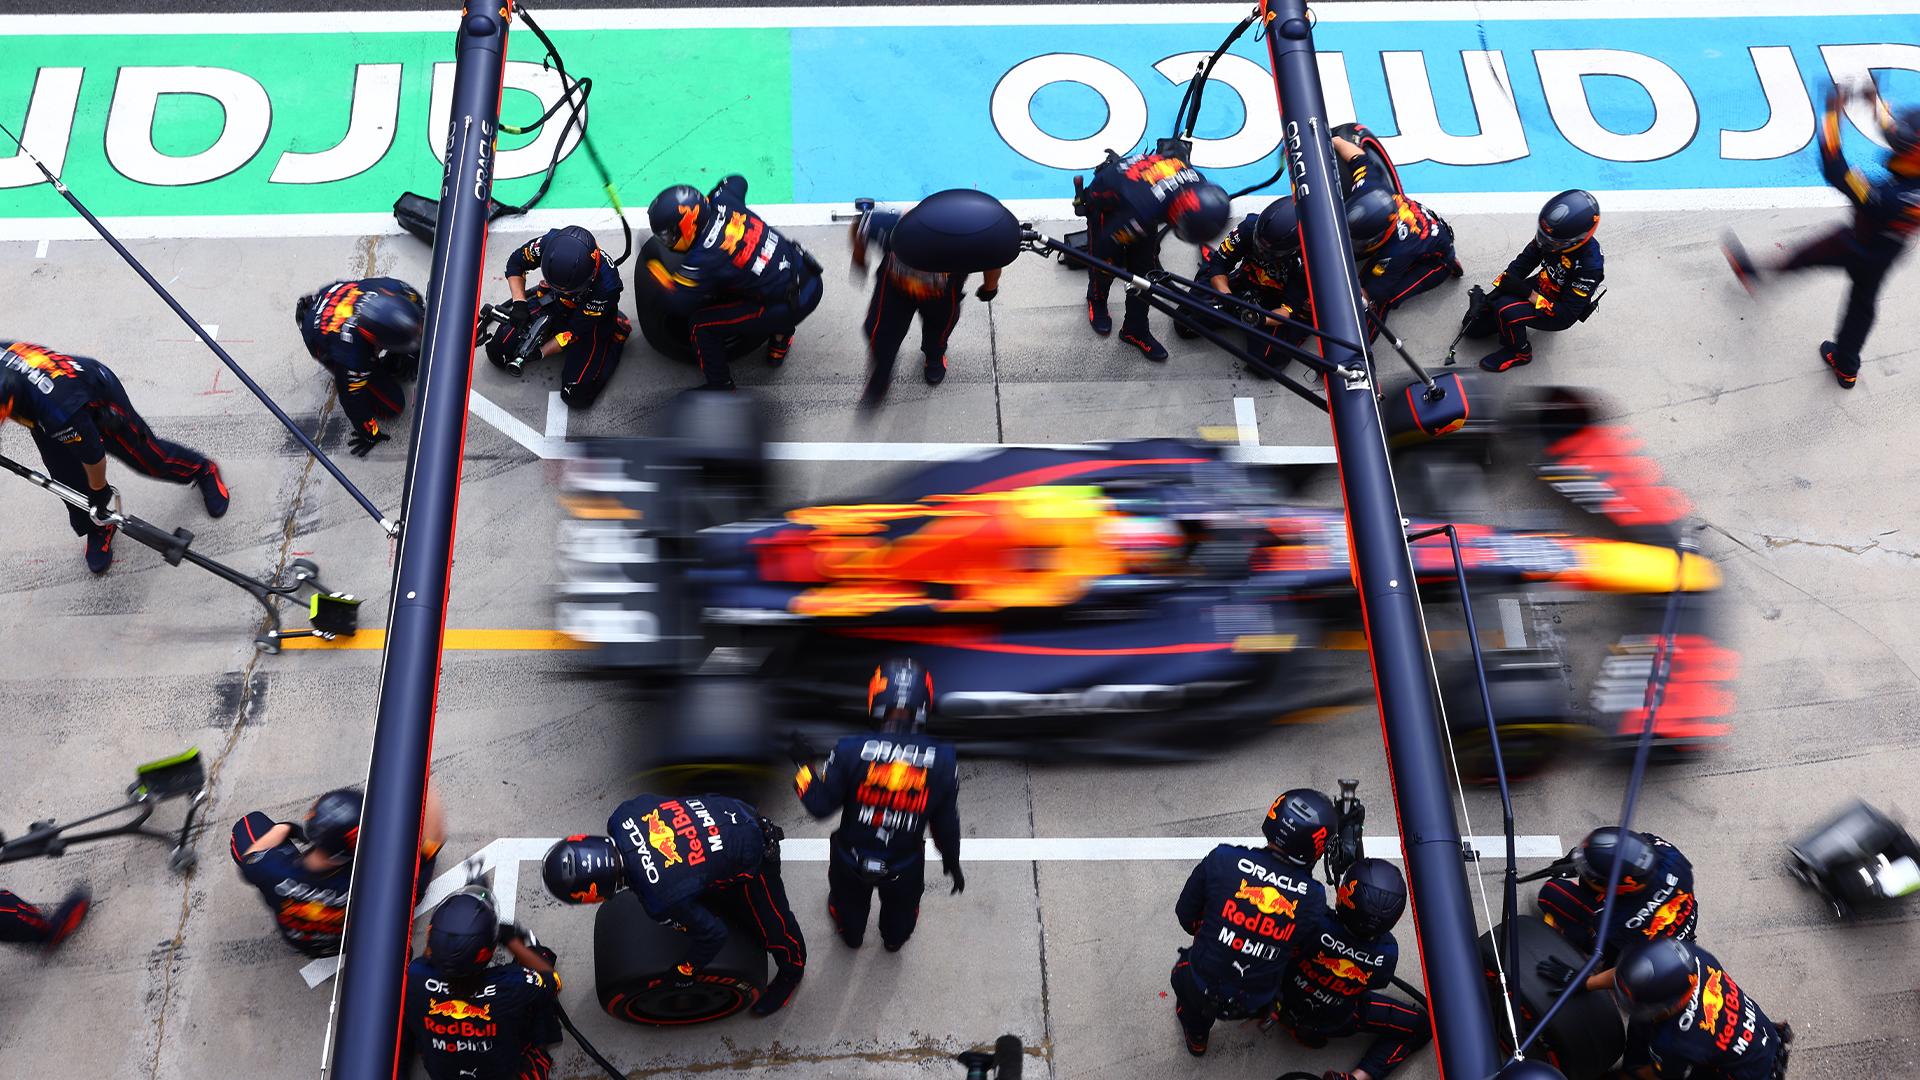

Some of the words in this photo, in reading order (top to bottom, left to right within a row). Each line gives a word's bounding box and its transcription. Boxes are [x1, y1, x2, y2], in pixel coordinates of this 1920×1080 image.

[474, 119, 493, 201] ORACLE
[1286, 120, 1311, 201] ORACLE
[622, 817, 660, 884] ORACLE
[697, 811, 724, 853] Mobil
[1237, 857, 1308, 895] ORACLE
[1624, 872, 1679, 929] ORACLE
[1218, 927, 1263, 957] Mobil
[1320, 933, 1384, 966] ORACLE
[432, 1037, 477, 1052] Mobil
[1732, 1006, 1756, 1056] Mobil
